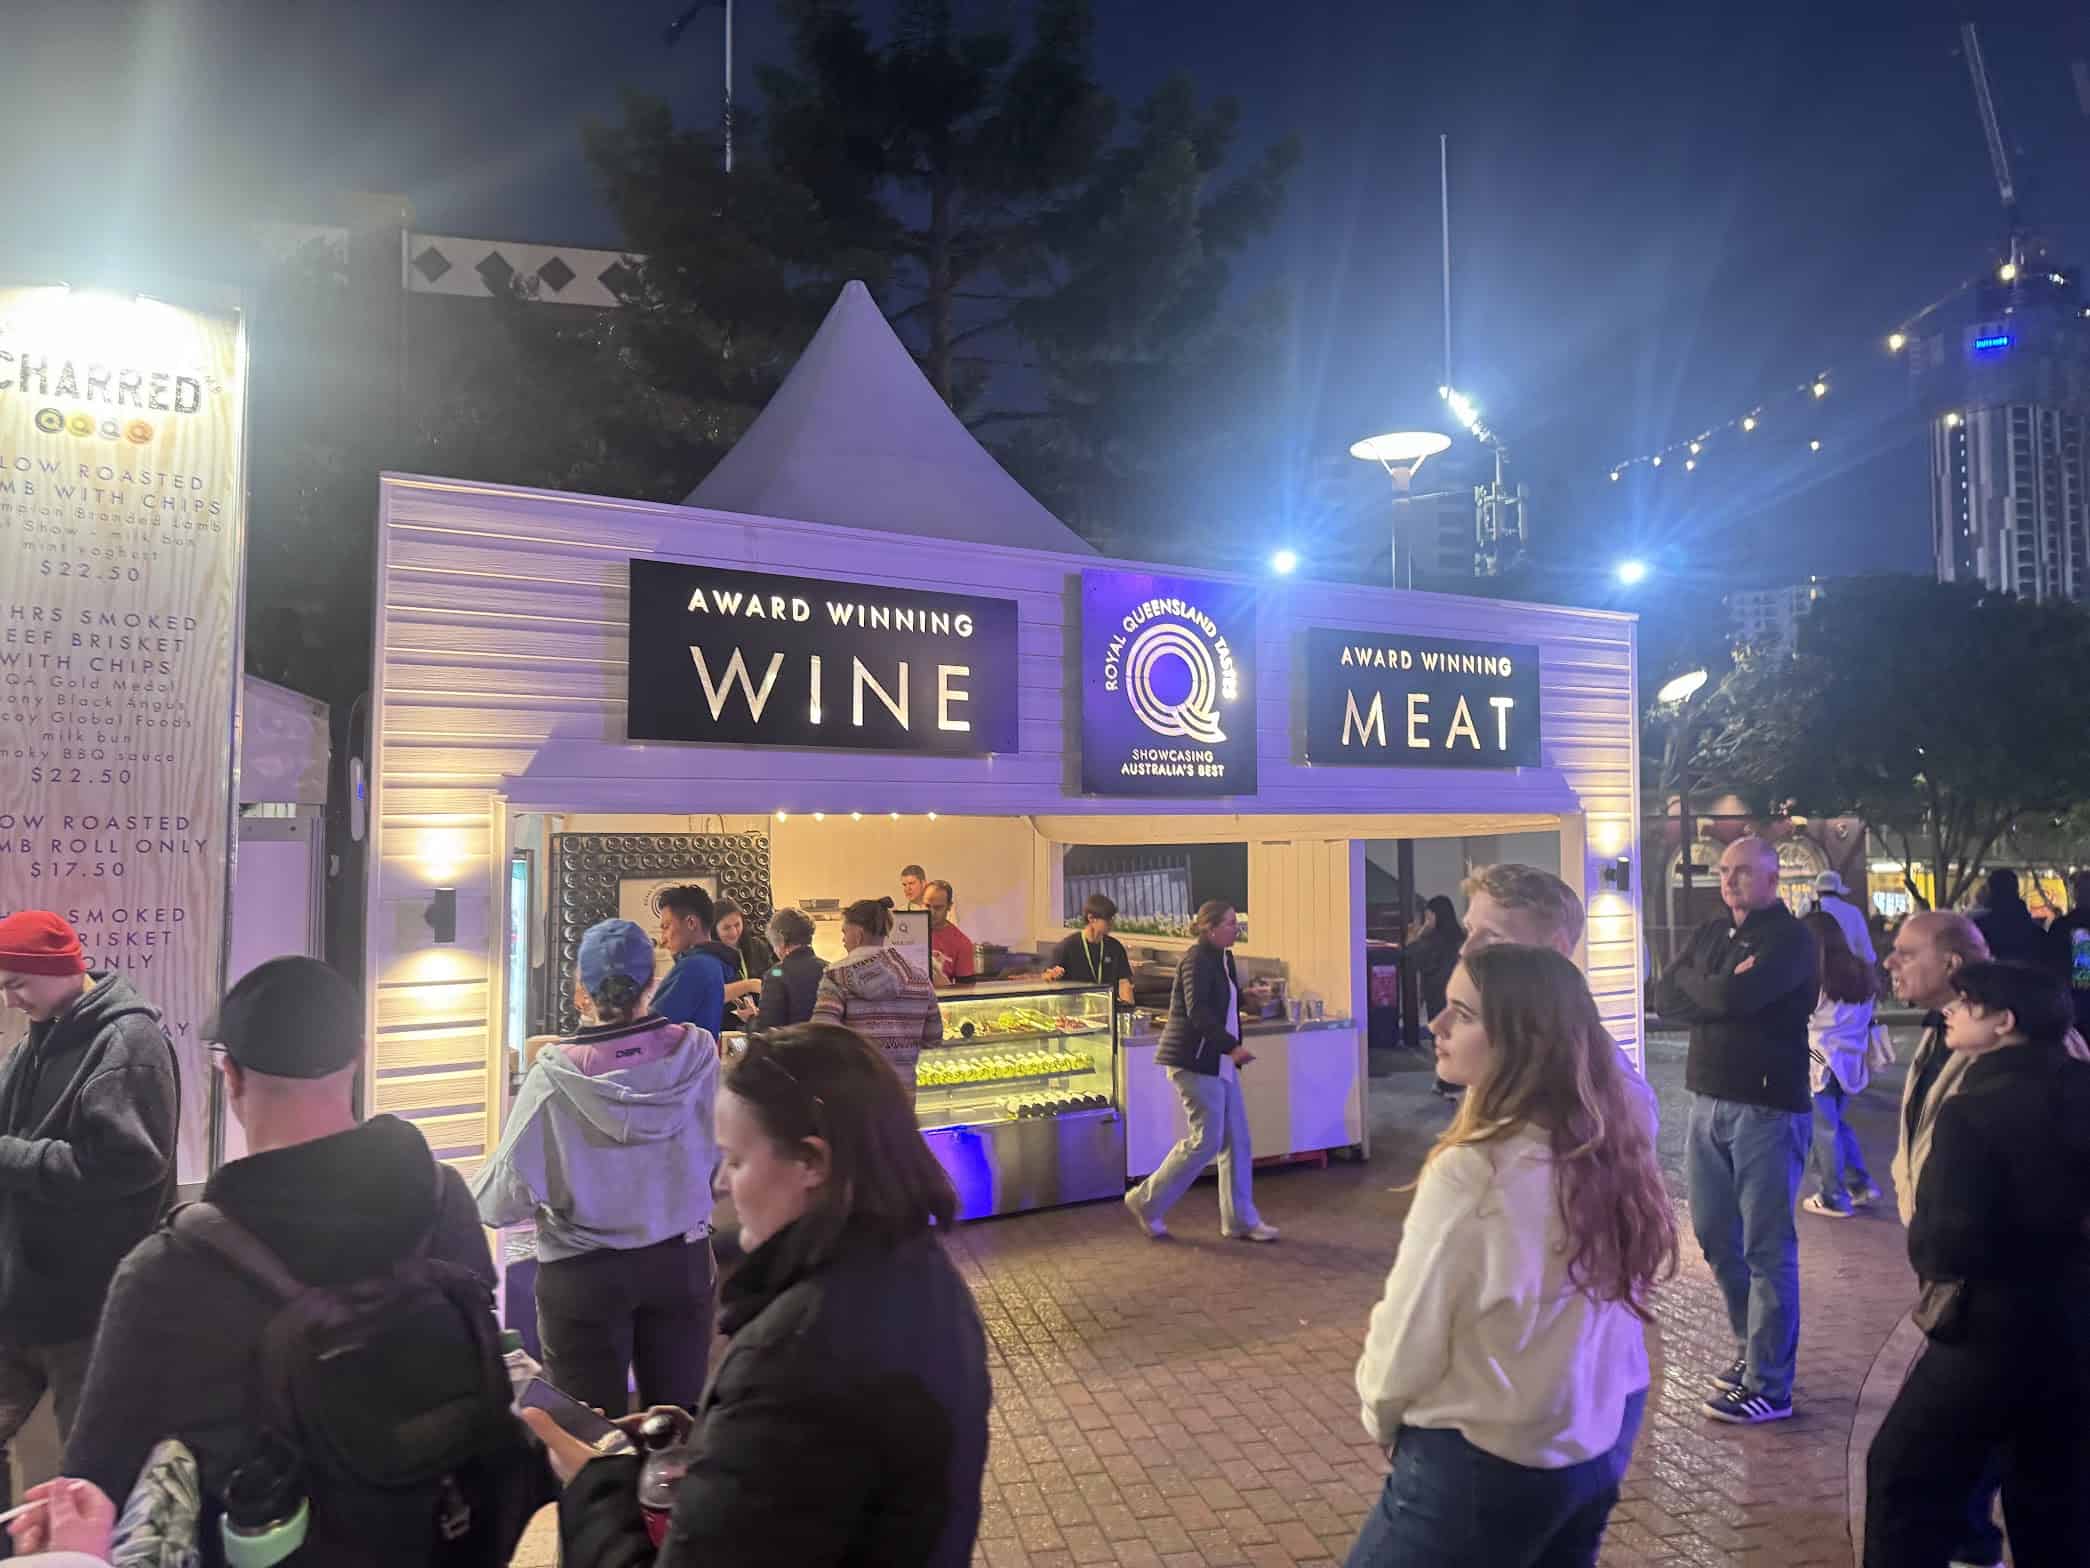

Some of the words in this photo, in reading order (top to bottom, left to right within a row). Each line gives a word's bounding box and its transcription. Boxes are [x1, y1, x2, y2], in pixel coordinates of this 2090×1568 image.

[79, 463, 203, 491] ROASTED
[54, 484, 124, 505] WITH
[143, 494, 221, 516] CHIPS
[40, 559, 140, 581] $22.50
[10, 605, 63, 622] HRS
[80, 610, 197, 631] SMOKED
[687, 587, 811, 623] AWARD
[827, 601, 974, 638] WINNING
[71, 632, 184, 652] BRISKET
[1104, 634, 1128, 691] ROYAL
[1122, 597, 1217, 639] QUEENSLAND
[0, 653, 71, 670] WITH
[89, 656, 171, 675] CHIPS
[1341, 645, 1413, 671] AWARD
[1420, 650, 1513, 678] WINNING
[50, 675, 100, 689] Gold
[112, 679, 176, 693] Medal
[689, 645, 971, 732] WINE
[57, 693, 112, 707] Black
[51, 711, 123, 726] Global
[135, 714, 192, 728] Foods
[1341, 688, 1514, 751] MEAT
[42, 728, 85, 742] milk
[97, 730, 131, 744] bun
[63, 747, 105, 761] BBQ
[1132, 748, 1214, 763] SHOWCASING
[31, 766, 132, 785] $22.50
[1120, 763, 1194, 777] AUSTRALIA'S
[1198, 764, 1225, 778] BEST
[64, 816, 191, 831] ROASTED
[51, 838, 120, 854] ROLL
[135, 839, 209, 854] ONLY
[30, 861, 126, 878] $17.50
[69, 908, 186, 924] SMOKED
[84, 954, 153, 969] ONLY
